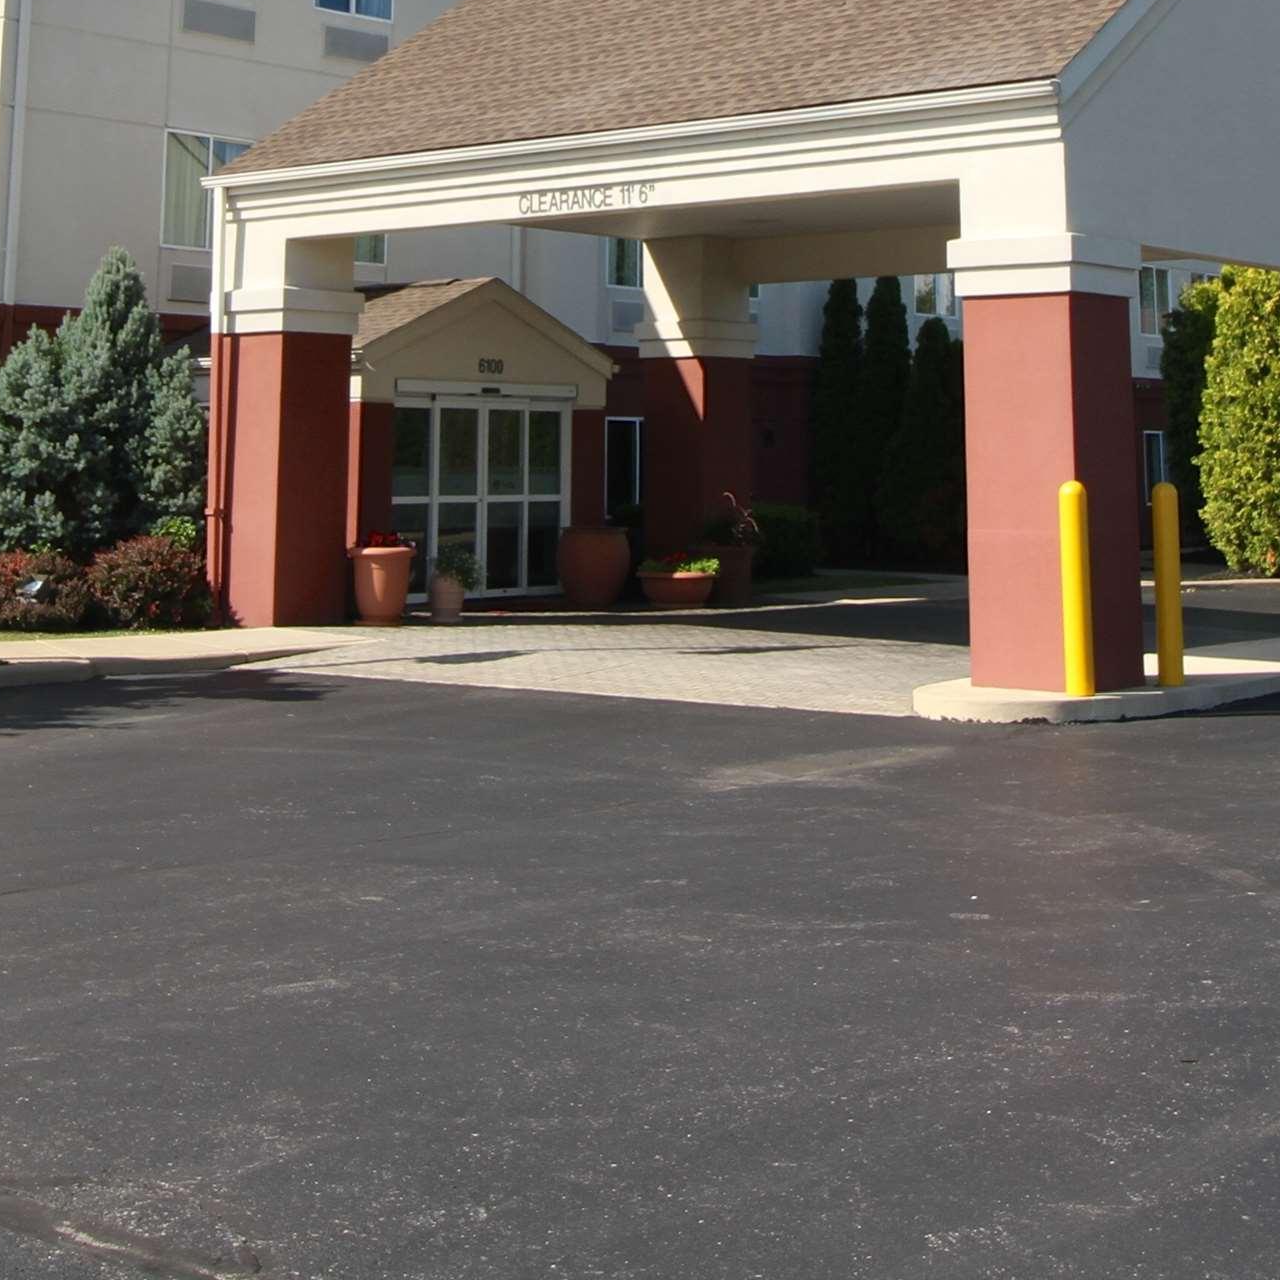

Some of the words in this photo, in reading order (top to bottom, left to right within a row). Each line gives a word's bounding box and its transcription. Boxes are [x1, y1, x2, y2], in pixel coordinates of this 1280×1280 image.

[519, 186, 613, 215] CLEARANCE
[638, 183, 655, 204] 6"
[478, 358, 504, 375] 6100
